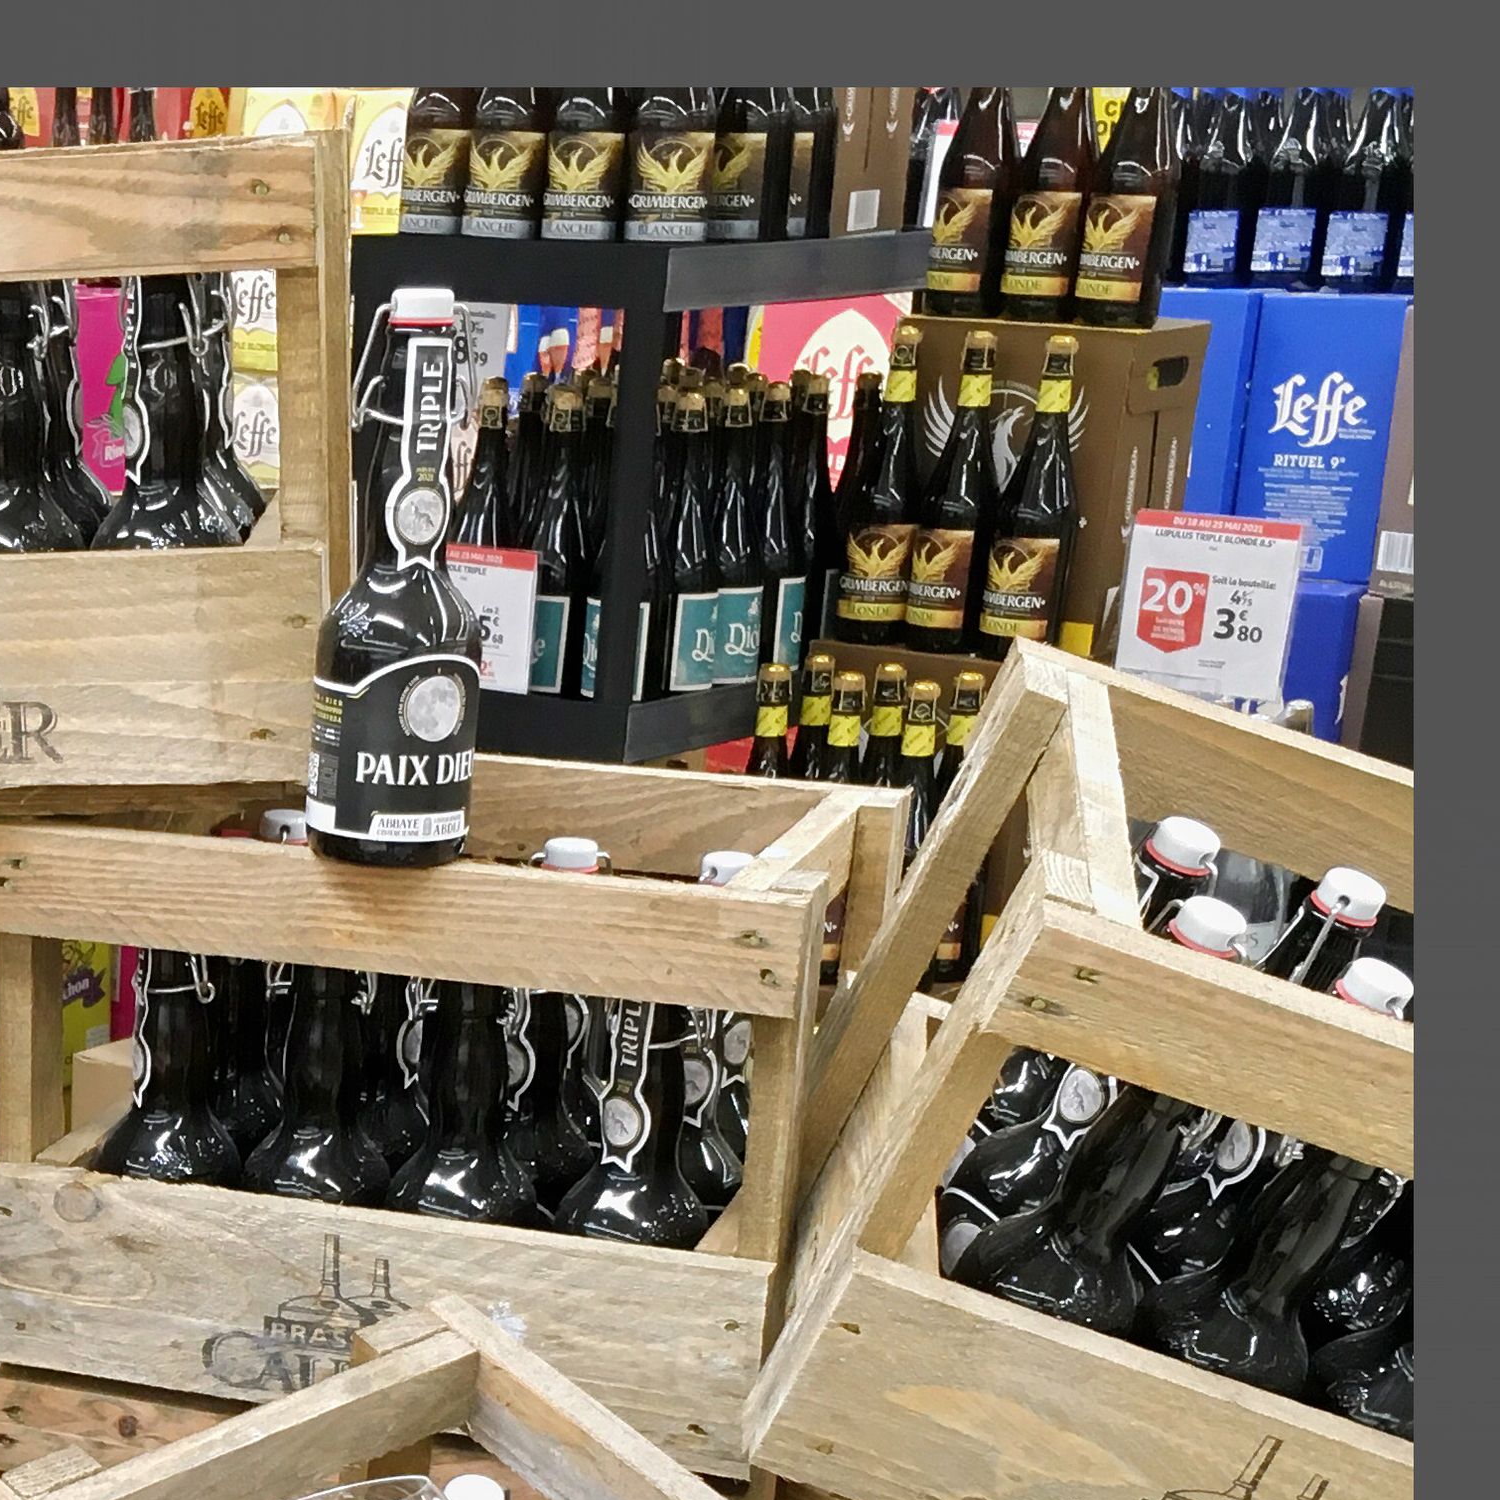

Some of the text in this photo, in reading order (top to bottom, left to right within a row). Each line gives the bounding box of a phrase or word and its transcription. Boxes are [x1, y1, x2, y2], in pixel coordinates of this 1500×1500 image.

[631, 193, 707, 209] GRIMBERGEN
[415, 359, 443, 455] TRIPLE
[1267, 371, 1368, 449] Leffe
[1273, 453, 1326, 469] RITUEL
[1172, 515, 1187, 526] DU
[1187, 517, 1198, 527] 18
[1198, 517, 1212, 529] AU
[1212, 519, 1224, 530] 25
[1224, 521, 1242, 532] MAI
[1154, 528, 1194, 540] LUPULUS
[1195, 532, 1223, 543] TRIPLE
[1224, 535, 1258, 547] BLONDE
[464, 565, 487, 576] TRIPLE
[1211, 574, 1228, 585] Soit
[1228, 576, 1238, 587] la
[355, 750, 430, 787] PAIX
